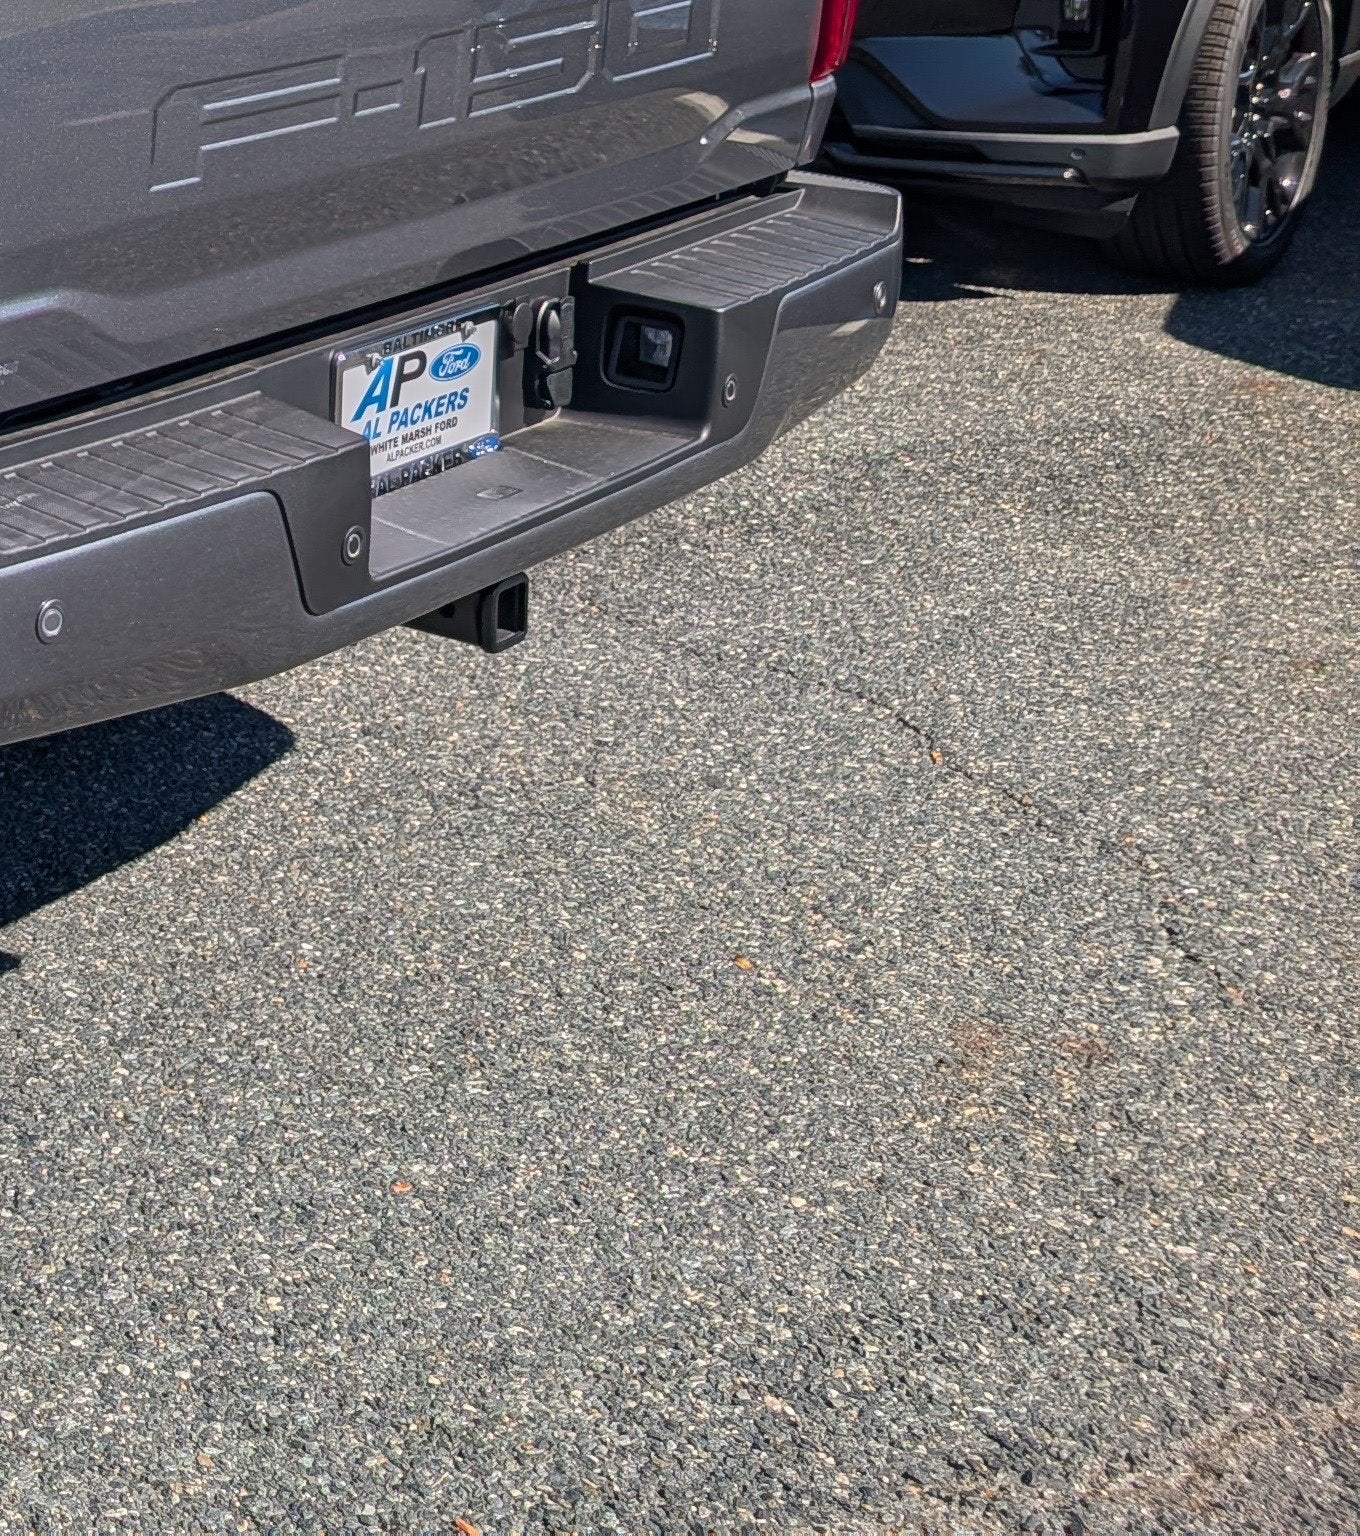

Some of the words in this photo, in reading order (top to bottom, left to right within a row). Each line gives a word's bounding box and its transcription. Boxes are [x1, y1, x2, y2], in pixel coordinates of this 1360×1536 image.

[350, 350, 427, 423] AP
[362, 416, 382, 440] AL
[387, 387, 470, 435] PACKERS
[370, 435, 399, 455] WHITE
[401, 424, 432, 444] MARSH
[434, 416, 458, 433] FORD
[386, 434, 442, 462] ALPACKER.COM
